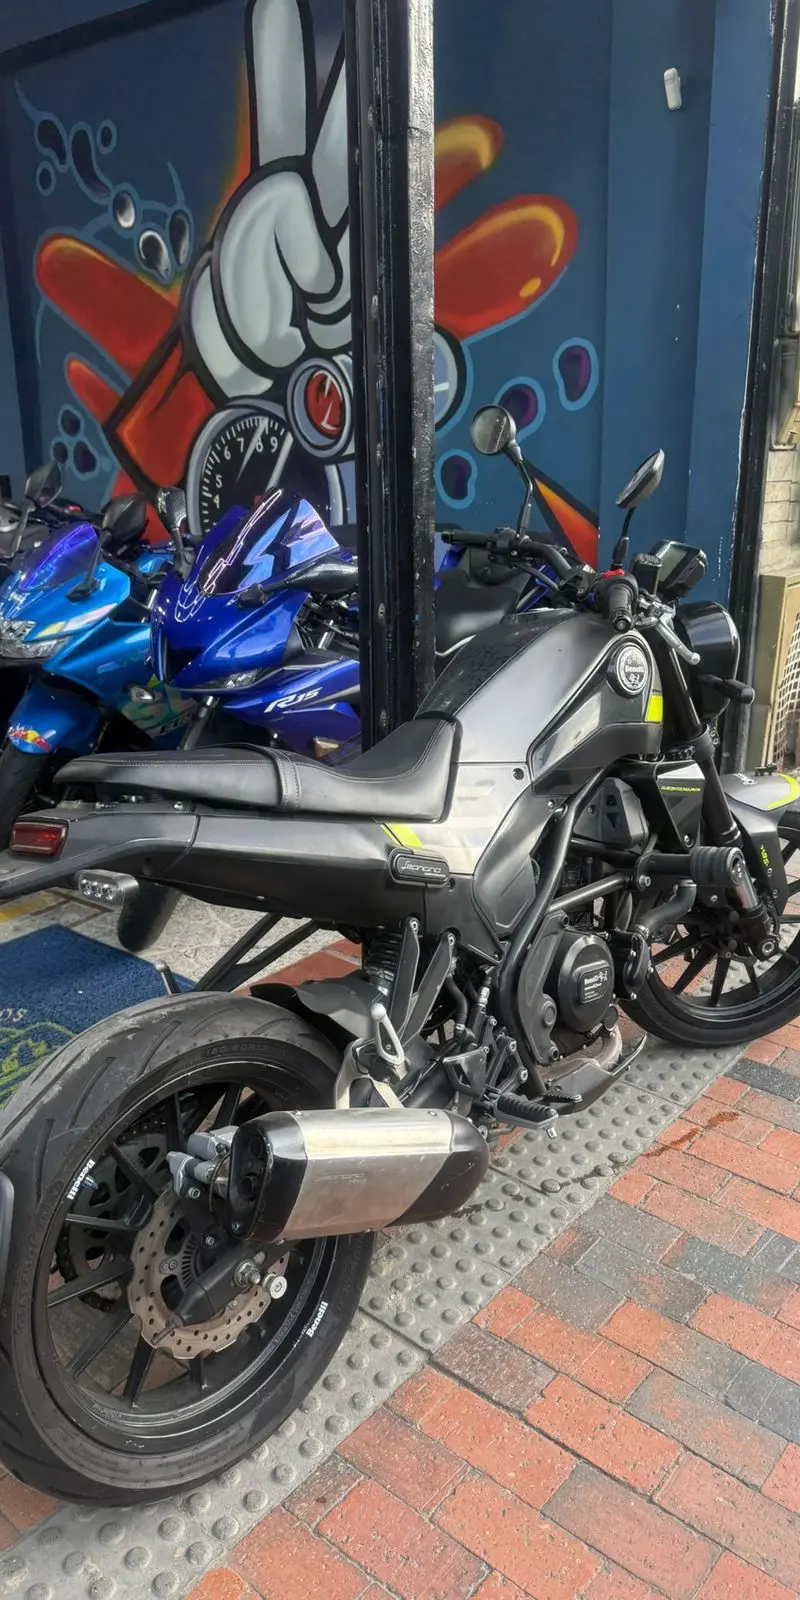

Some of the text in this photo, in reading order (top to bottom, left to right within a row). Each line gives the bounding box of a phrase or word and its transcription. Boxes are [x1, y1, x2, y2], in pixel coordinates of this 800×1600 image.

[223, 445, 231, 460] 6
[236, 437, 244, 453] 7
[270, 436, 279, 453] 9
[215, 474, 223, 488] 5
[213, 494, 220, 509] 4
[264, 686, 323, 713] R15
[66, 1158, 96, 1200] Benelli
[306, 1300, 329, 1338] Benelli
